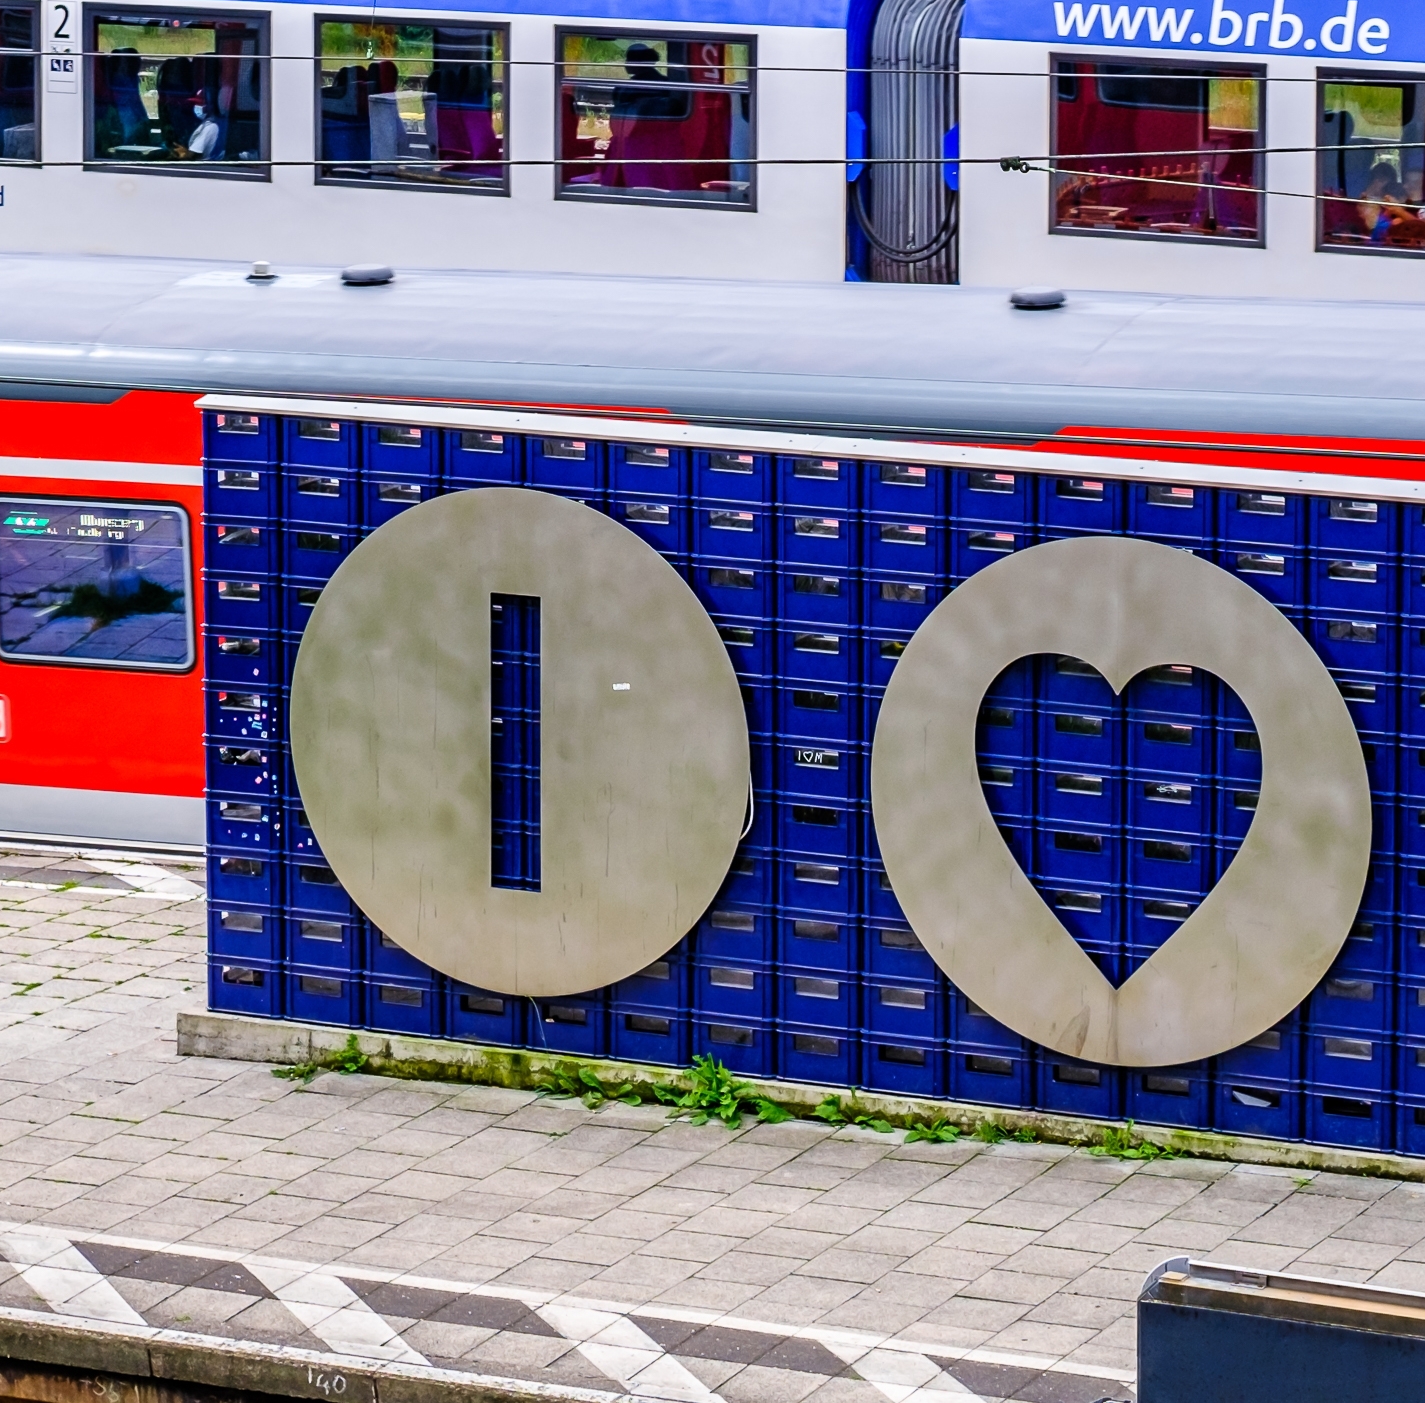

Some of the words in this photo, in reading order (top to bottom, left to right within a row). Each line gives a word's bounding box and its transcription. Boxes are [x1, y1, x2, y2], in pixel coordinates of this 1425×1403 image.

[54, 5, 69, 37] 2
[490, 594, 541, 893] I
[307, 1367, 347, 1395] 140
